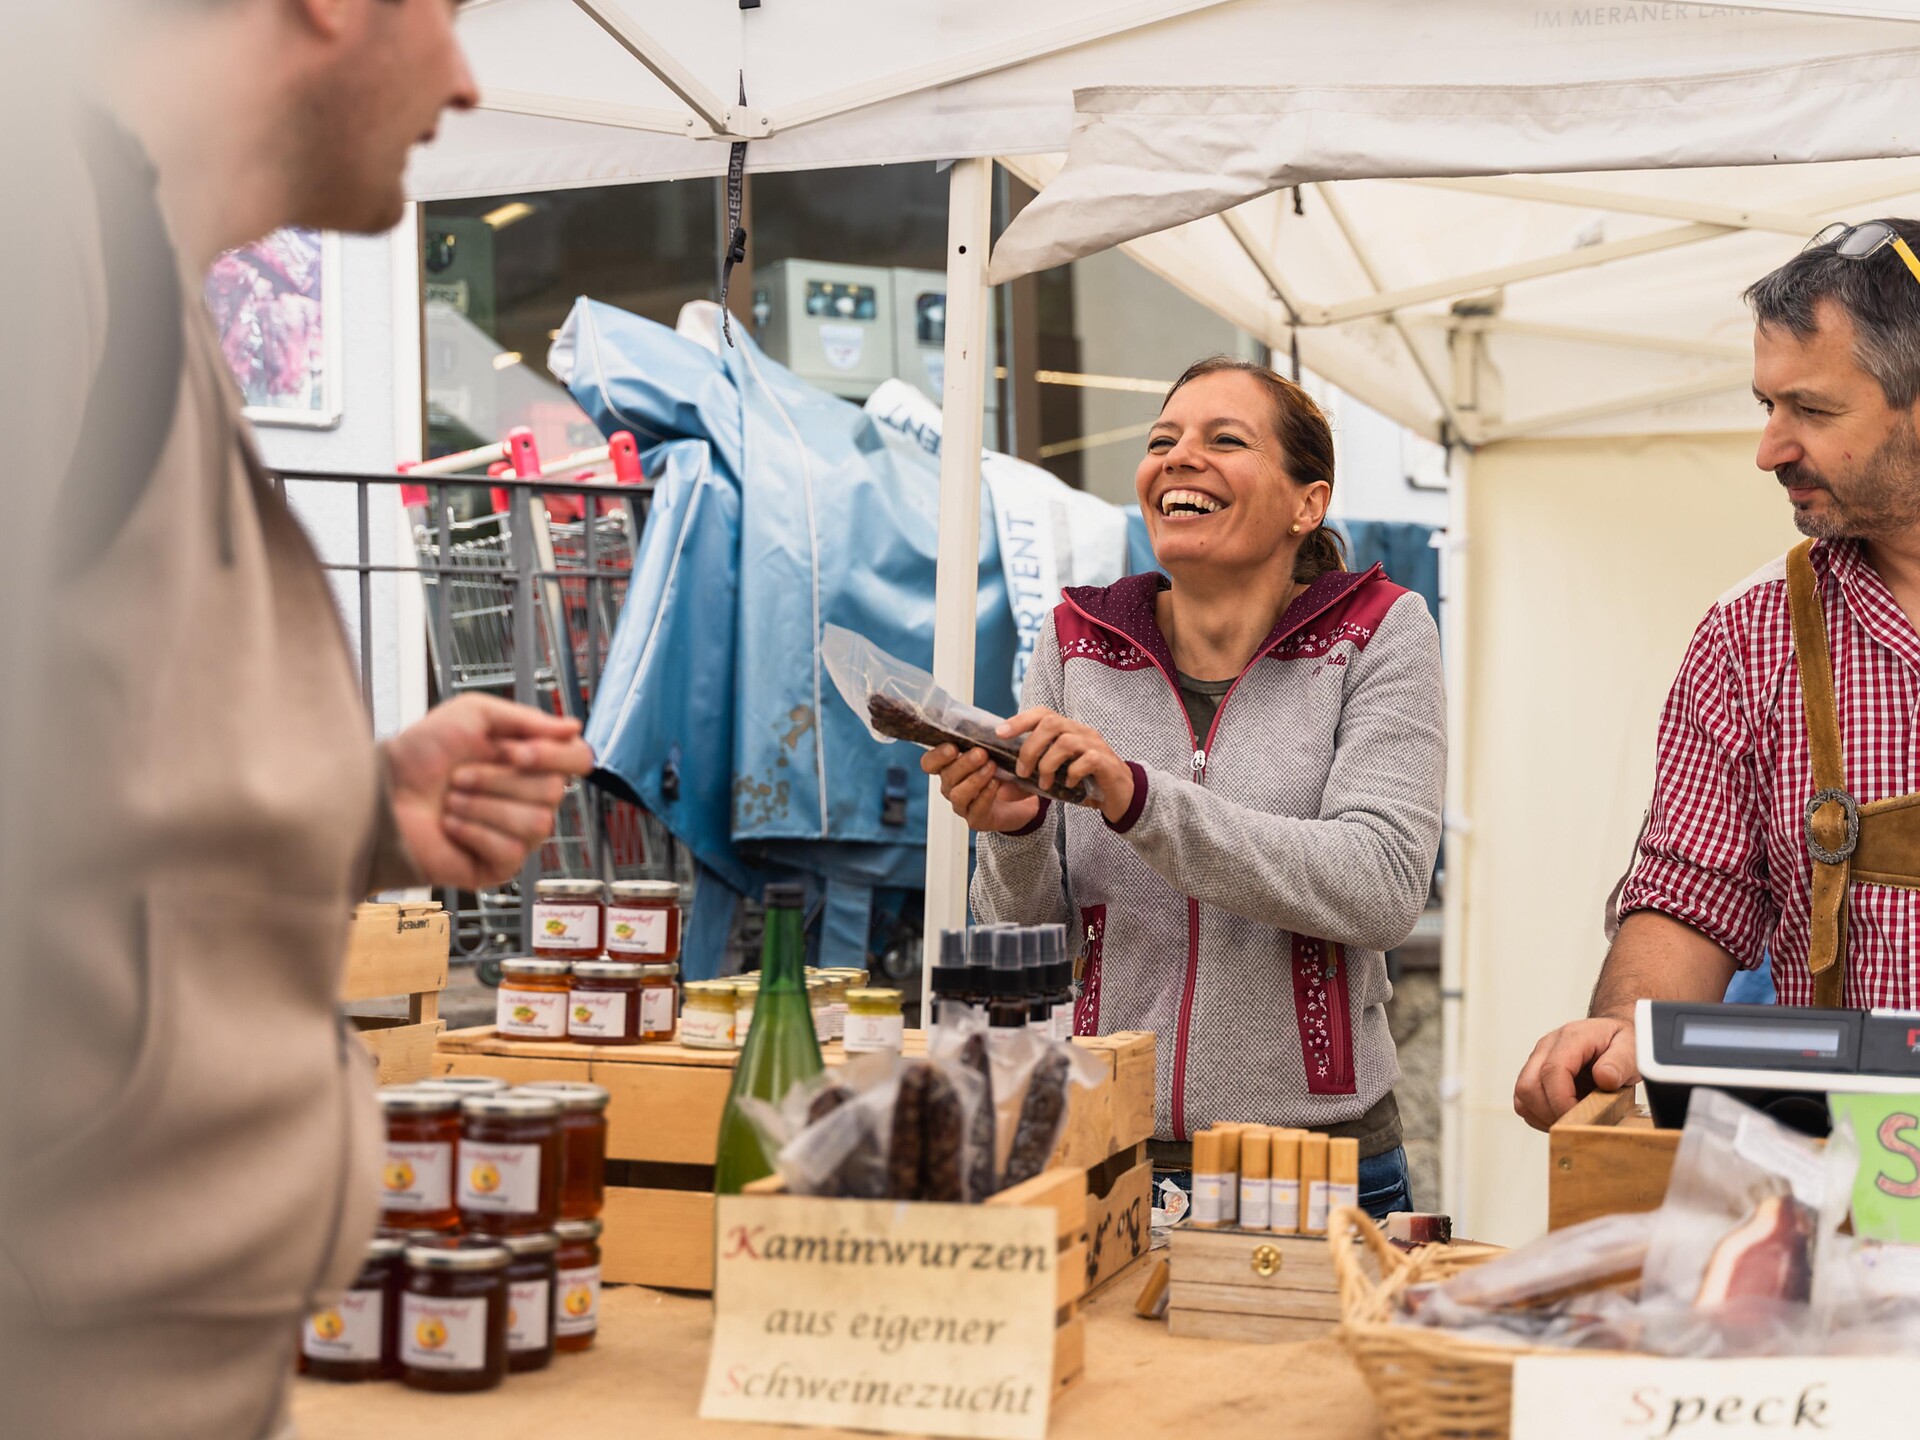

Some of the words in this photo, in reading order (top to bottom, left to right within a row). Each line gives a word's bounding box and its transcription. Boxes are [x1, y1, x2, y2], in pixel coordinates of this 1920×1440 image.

[1534, 11, 1562, 29] IM
[1571, 4, 1688, 27] MERANER
[723, 1225, 1048, 1273] Kaminwurzen
[764, 1309, 835, 1335] aus
[849, 1304, 1007, 1353] eigener
[718, 1361, 1035, 1415] Schweinezucht
[1623, 1382, 1828, 1439] Speck
